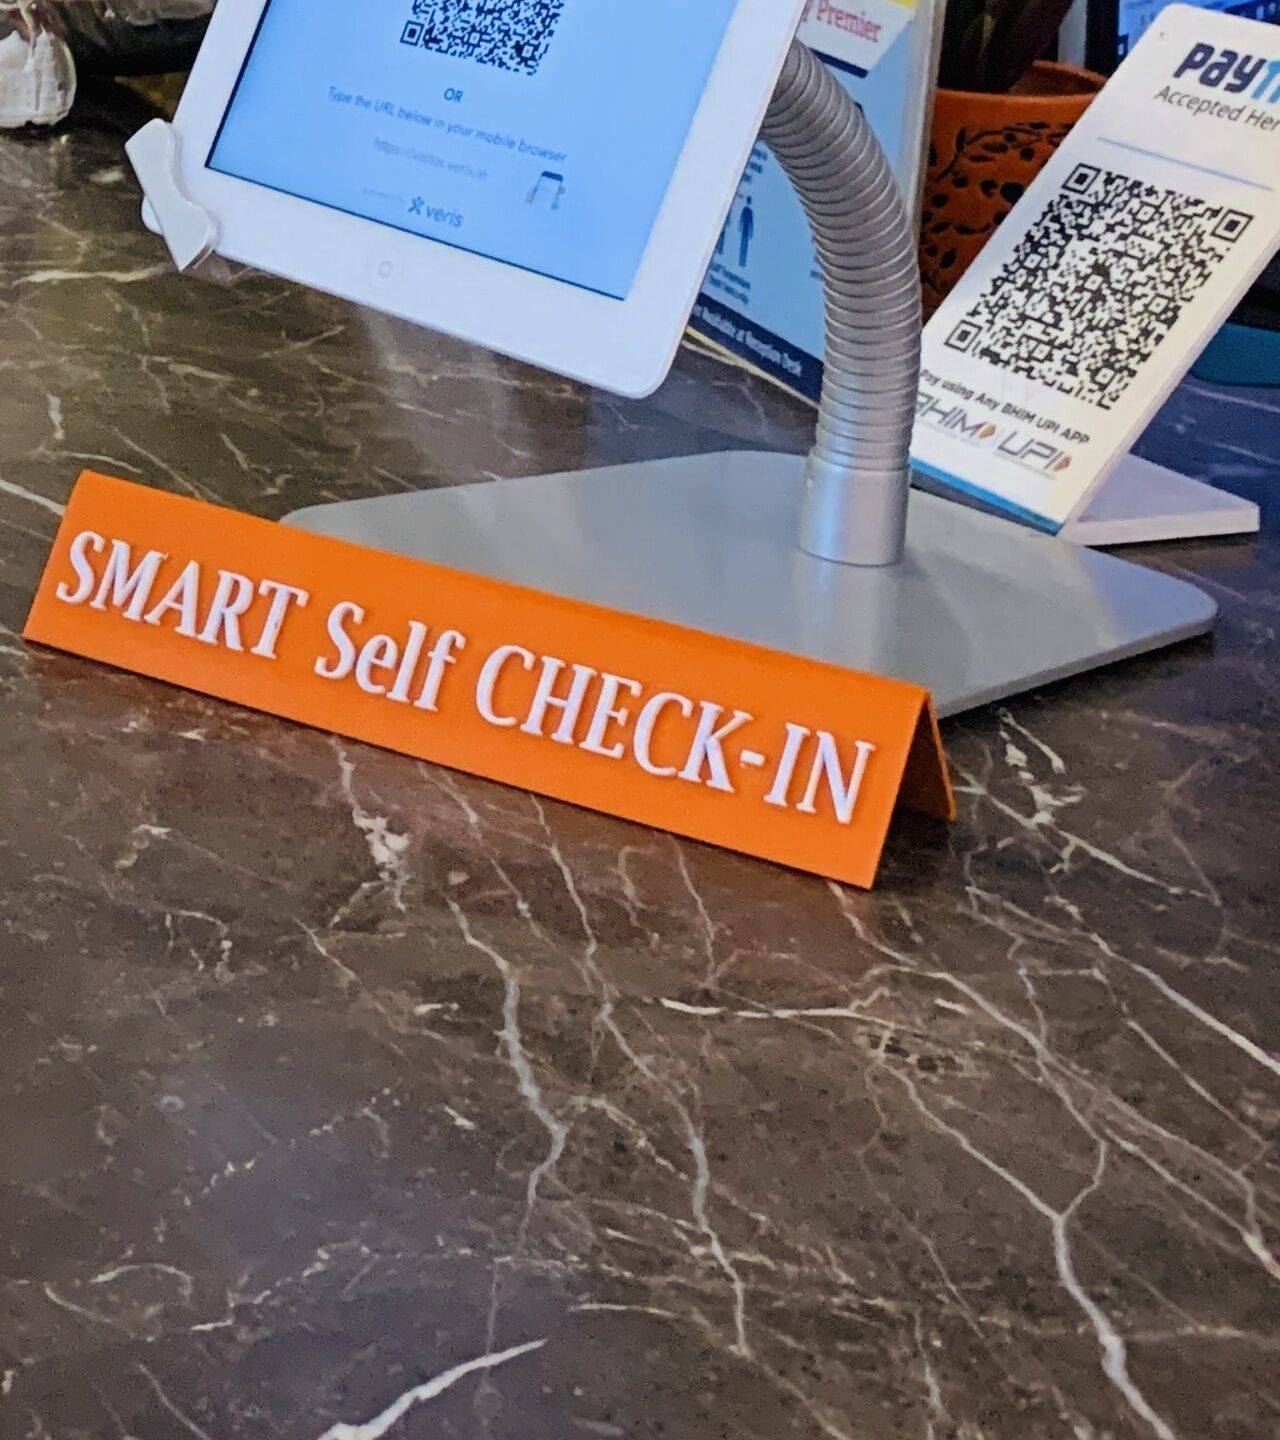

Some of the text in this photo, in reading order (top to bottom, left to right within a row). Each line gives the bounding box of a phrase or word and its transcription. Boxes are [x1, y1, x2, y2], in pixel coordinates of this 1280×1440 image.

[443, 87, 464, 103] OR
[1152, 84, 1280, 134] Accepted Her
[328, 85, 352, 105] Type
[354, 95, 373, 109] the
[374, 99, 394, 116] URL
[398, 107, 433, 126] below
[446, 122, 474, 136] your
[474, 128, 516, 150] mobile
[518, 138, 568, 162] browser
[426, 206, 464, 228] veris
[920, 368, 1091, 445] Pay using Any BHIM UPI APP
[997, 431, 1065, 470] UPI
[54, 527, 876, 827] SMART Self CHECK-IN
